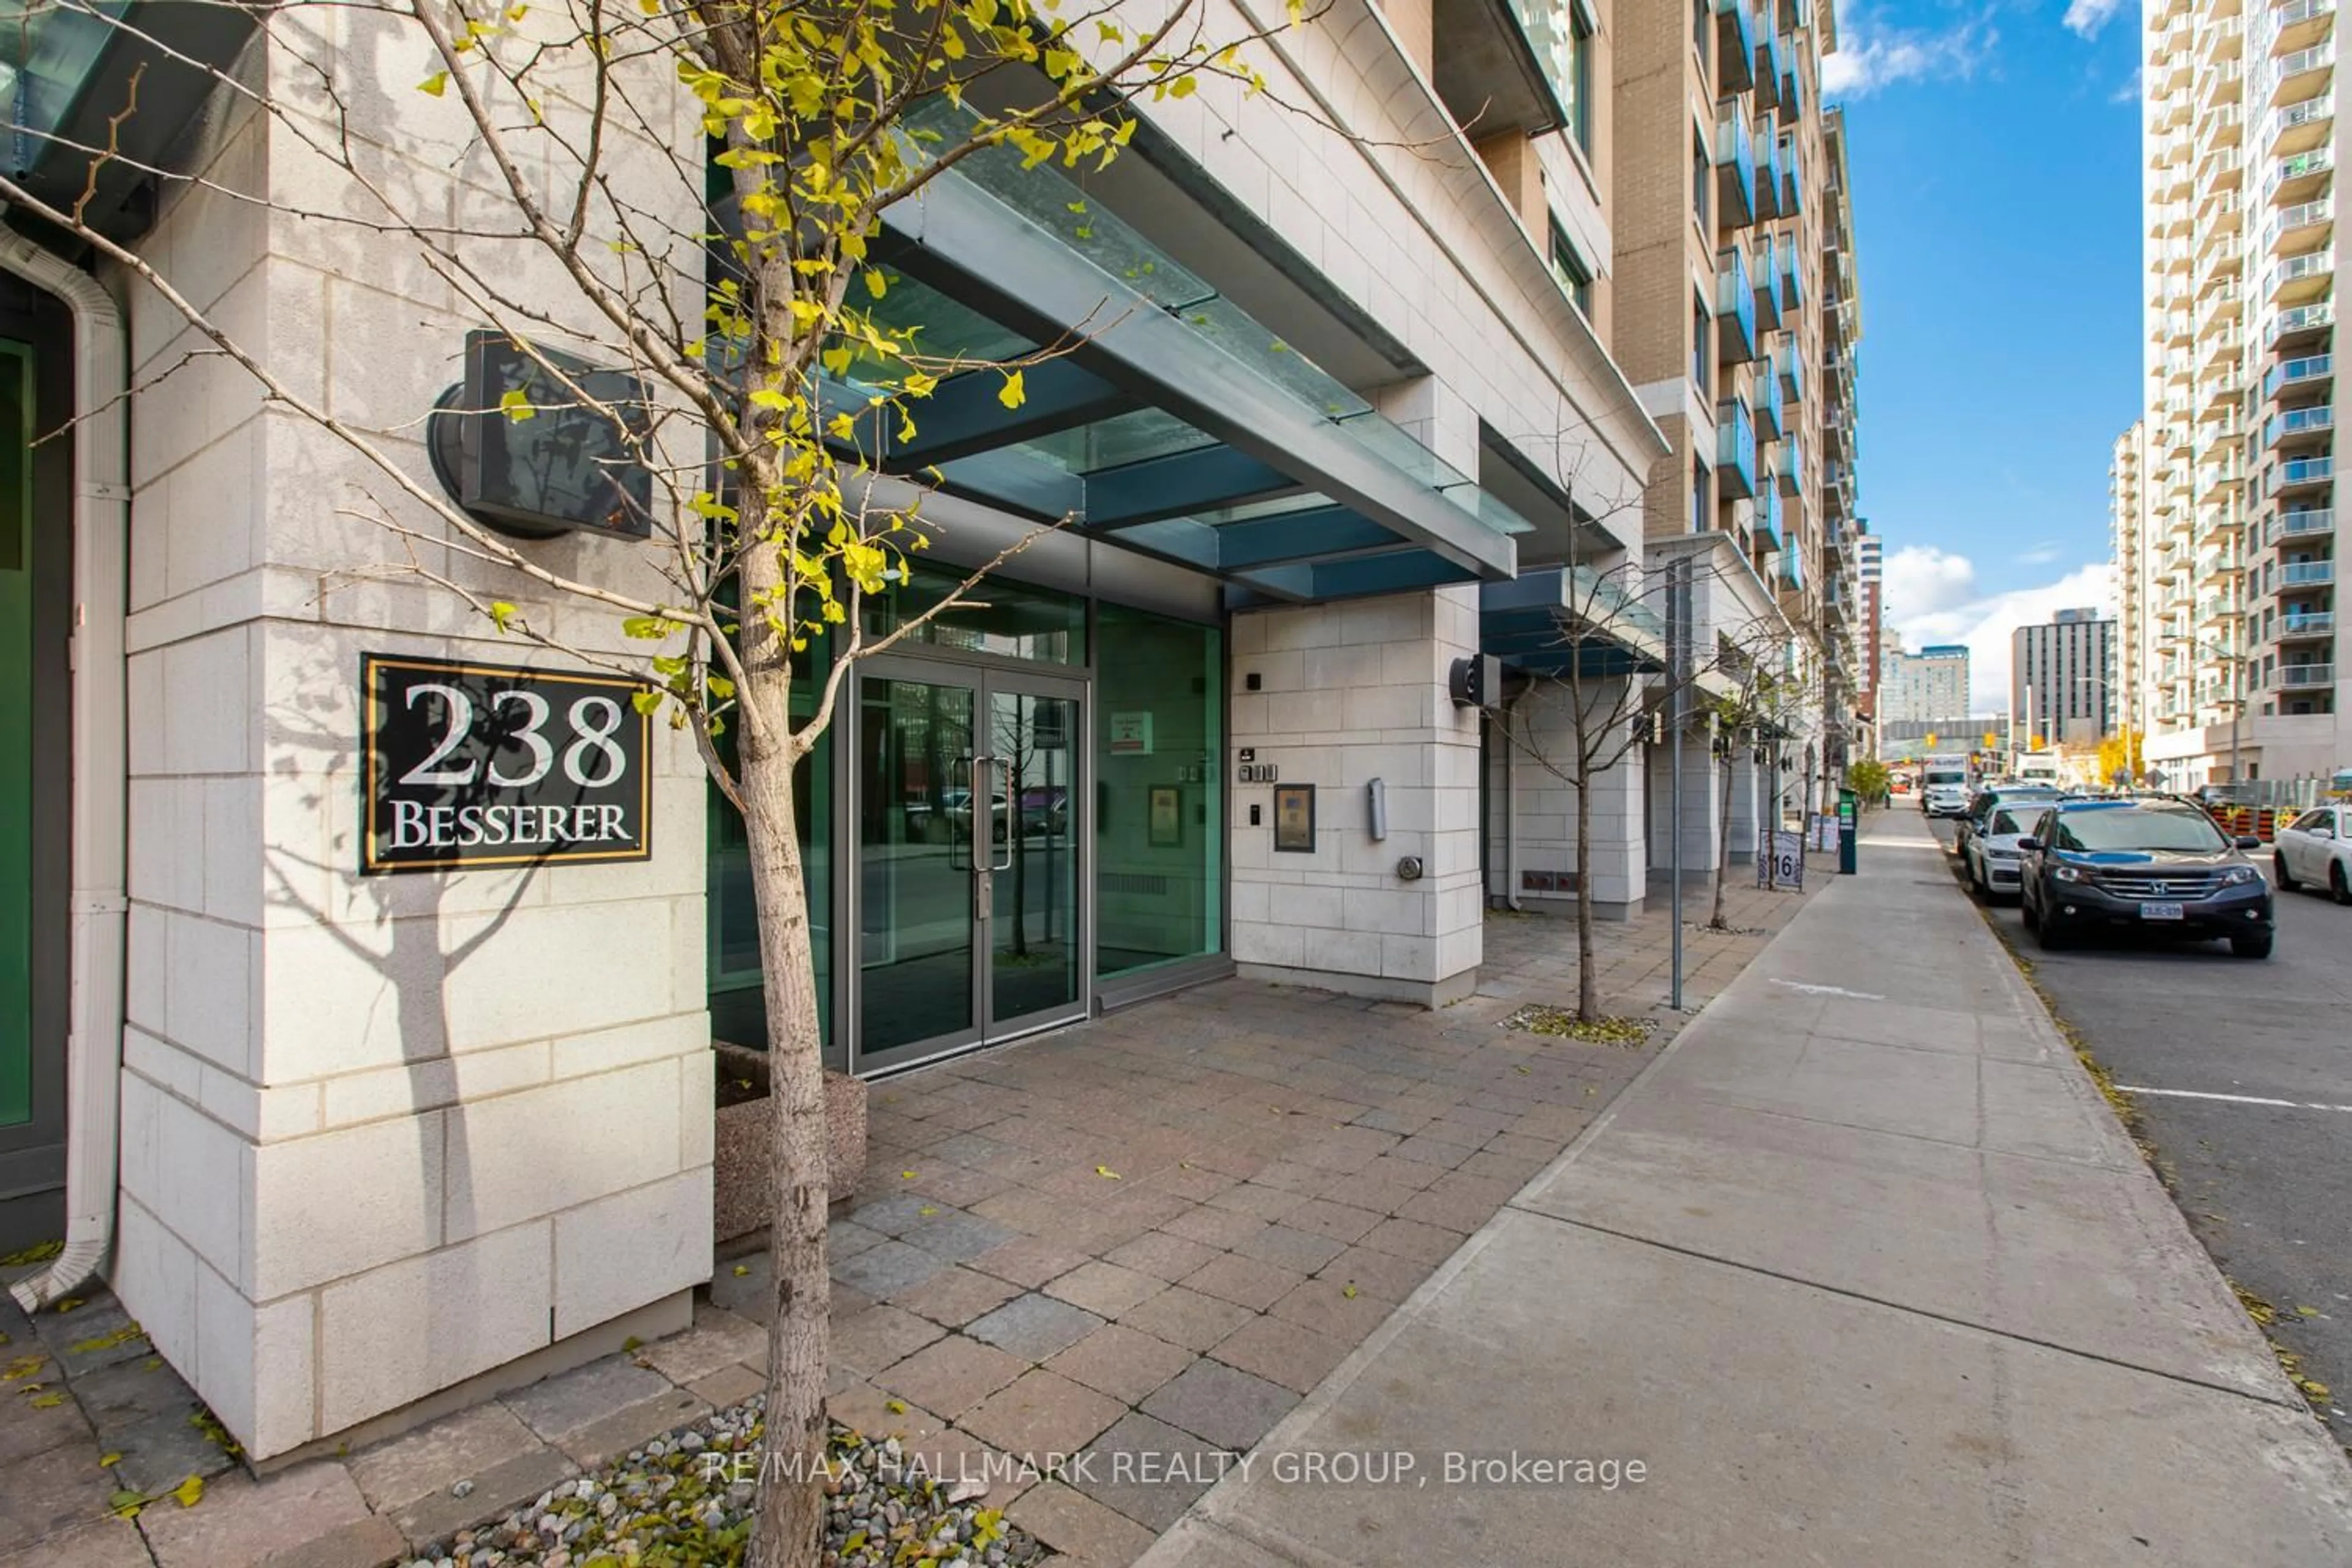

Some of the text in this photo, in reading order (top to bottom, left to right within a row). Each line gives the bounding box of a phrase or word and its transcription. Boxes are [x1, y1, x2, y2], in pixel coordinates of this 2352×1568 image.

[398, 683, 627, 788] 238
[388, 799, 633, 848] BESSERER
[1774, 854, 1792, 877] 16
